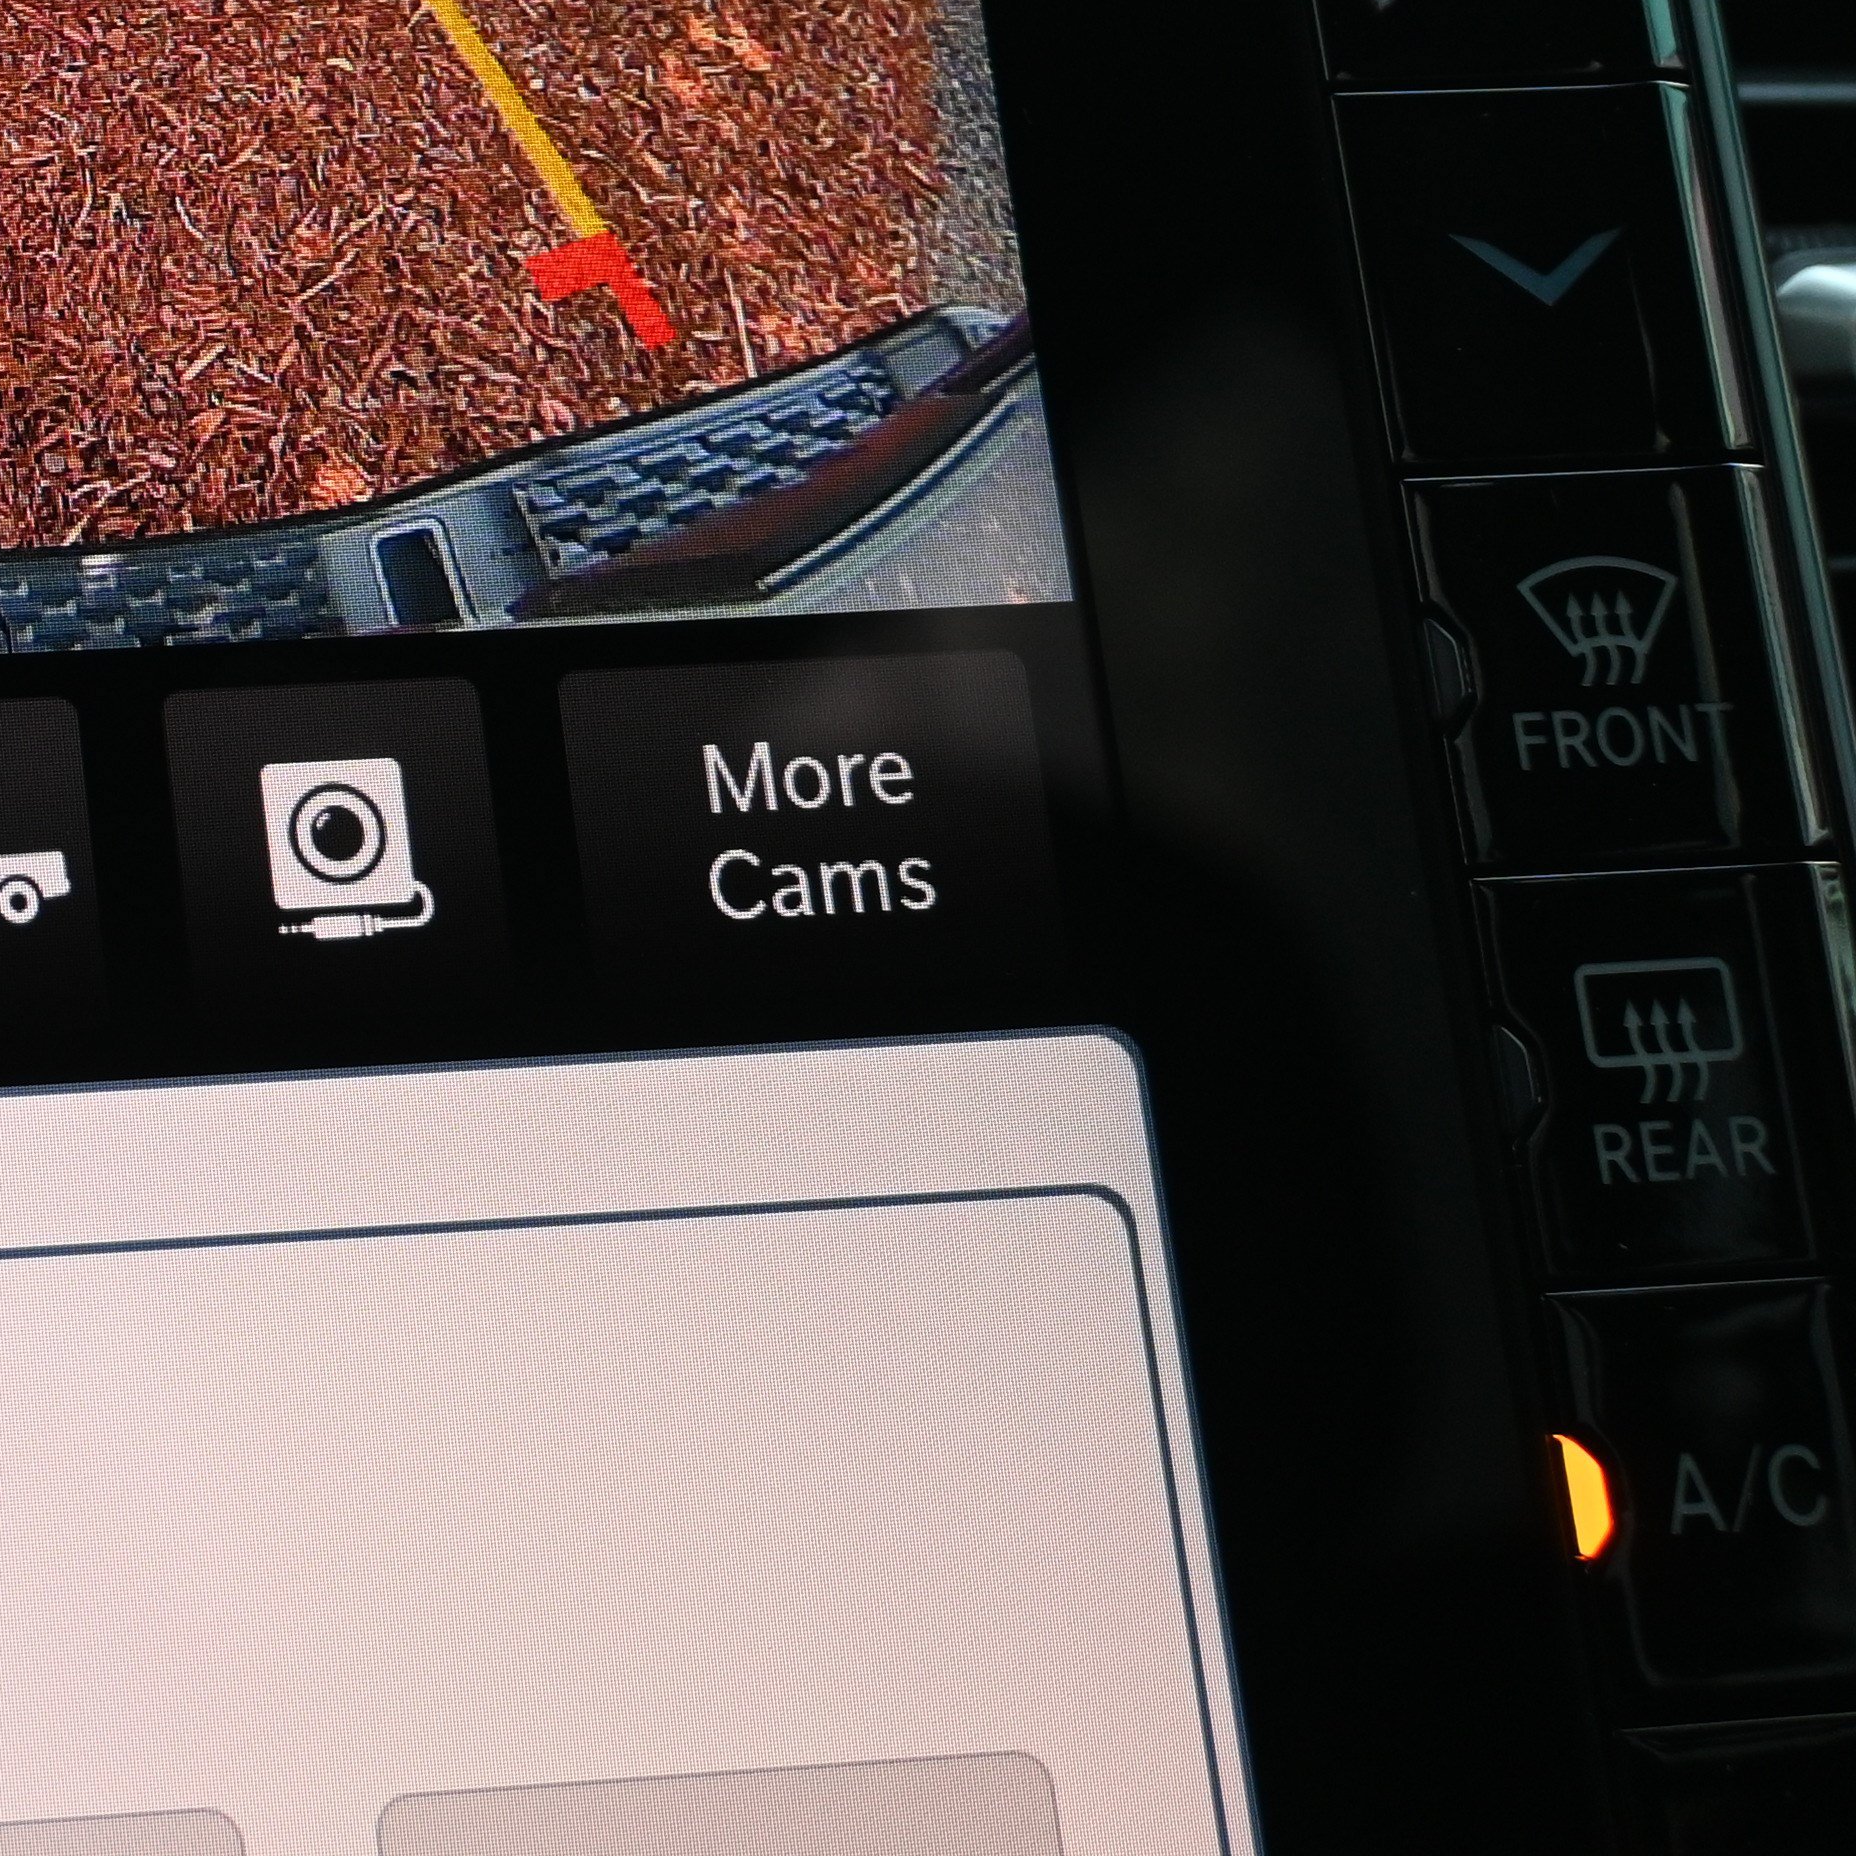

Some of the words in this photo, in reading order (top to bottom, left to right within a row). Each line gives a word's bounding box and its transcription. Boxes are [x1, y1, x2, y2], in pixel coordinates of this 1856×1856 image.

[1512, 702, 1735, 772] FRONT
[702, 740, 914, 814] More
[708, 847, 938, 921] Cams
[1593, 1114, 1776, 1186] REAR
[1670, 1443, 1830, 1536] A/C
